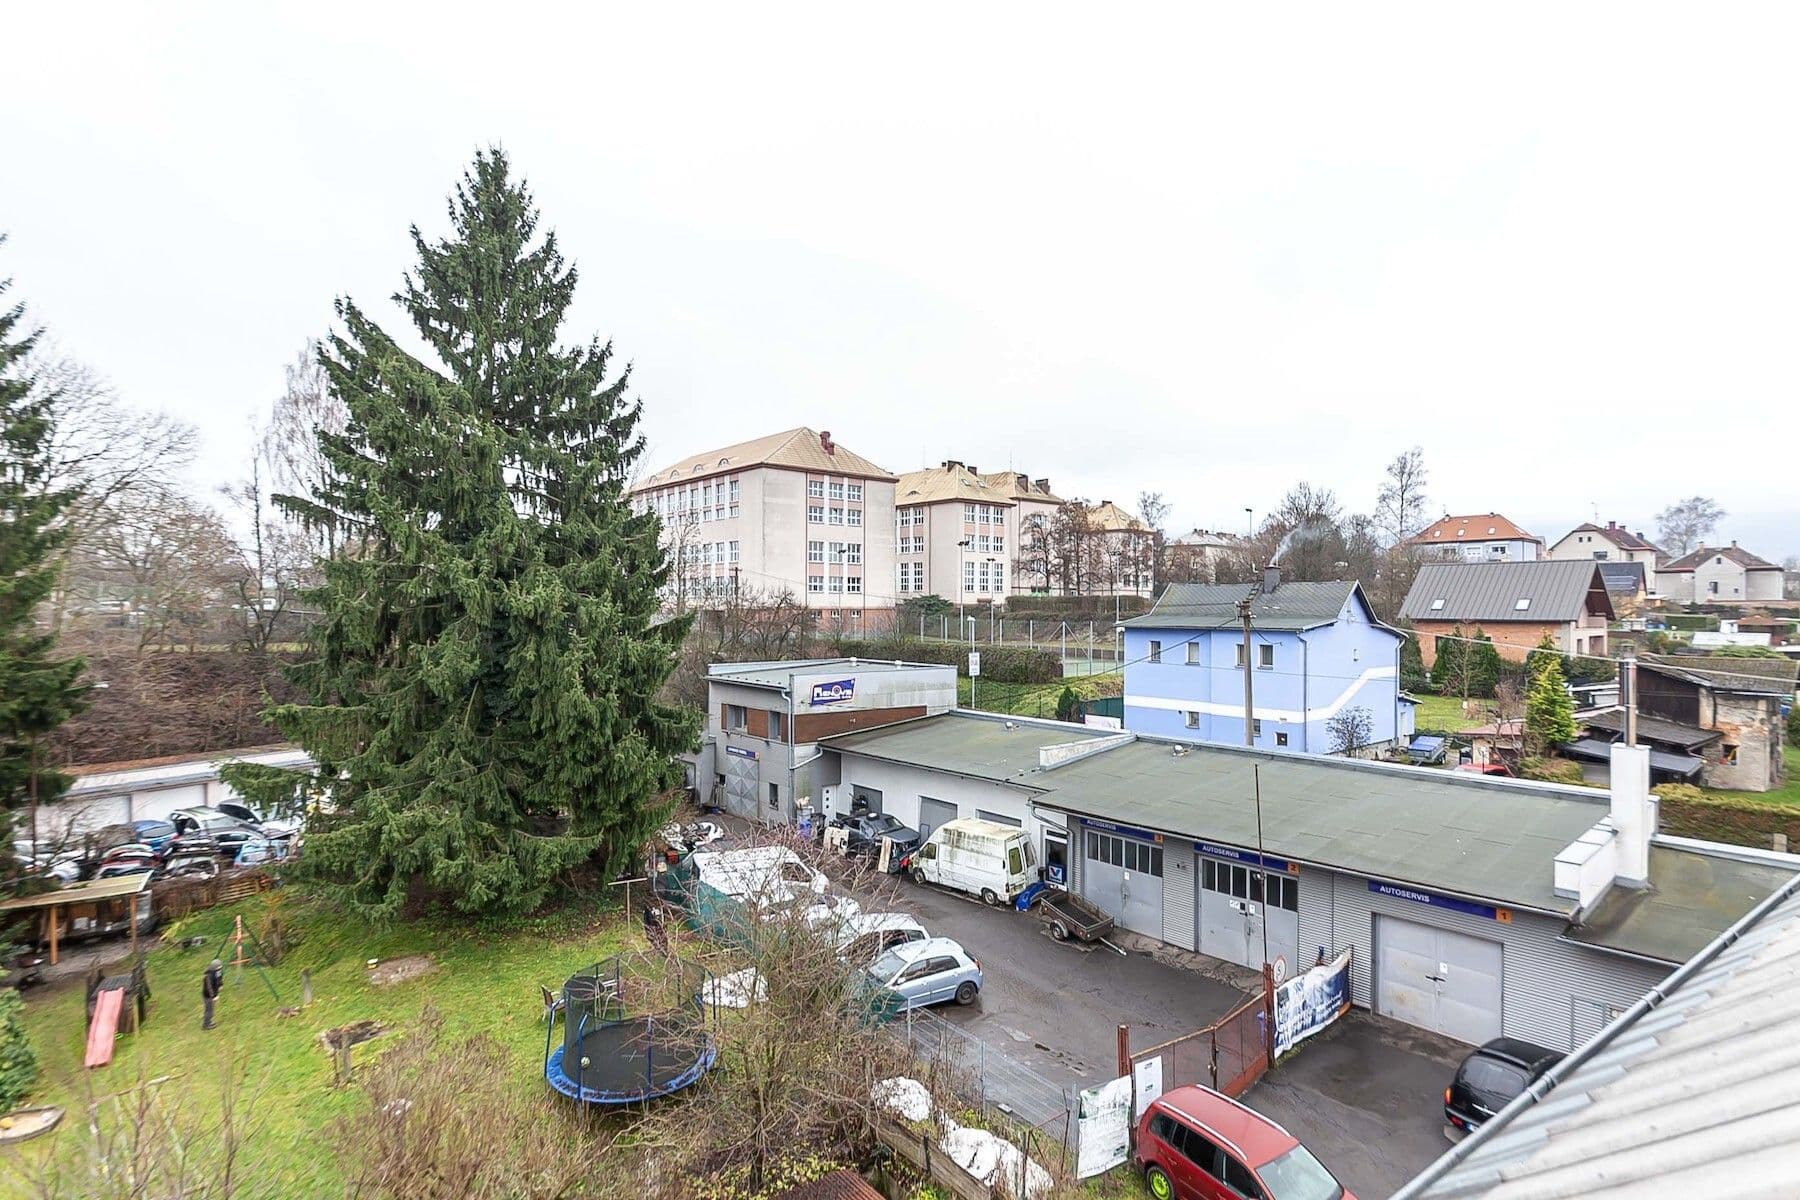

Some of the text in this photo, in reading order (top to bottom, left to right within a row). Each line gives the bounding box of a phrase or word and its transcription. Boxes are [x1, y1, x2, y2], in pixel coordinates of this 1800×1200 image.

[1086, 819, 1117, 831] AUTOSERVIS
[1202, 845, 1240, 859] AUTOSERVIS
[1379, 885, 1431, 903] AUTOSERVIS
